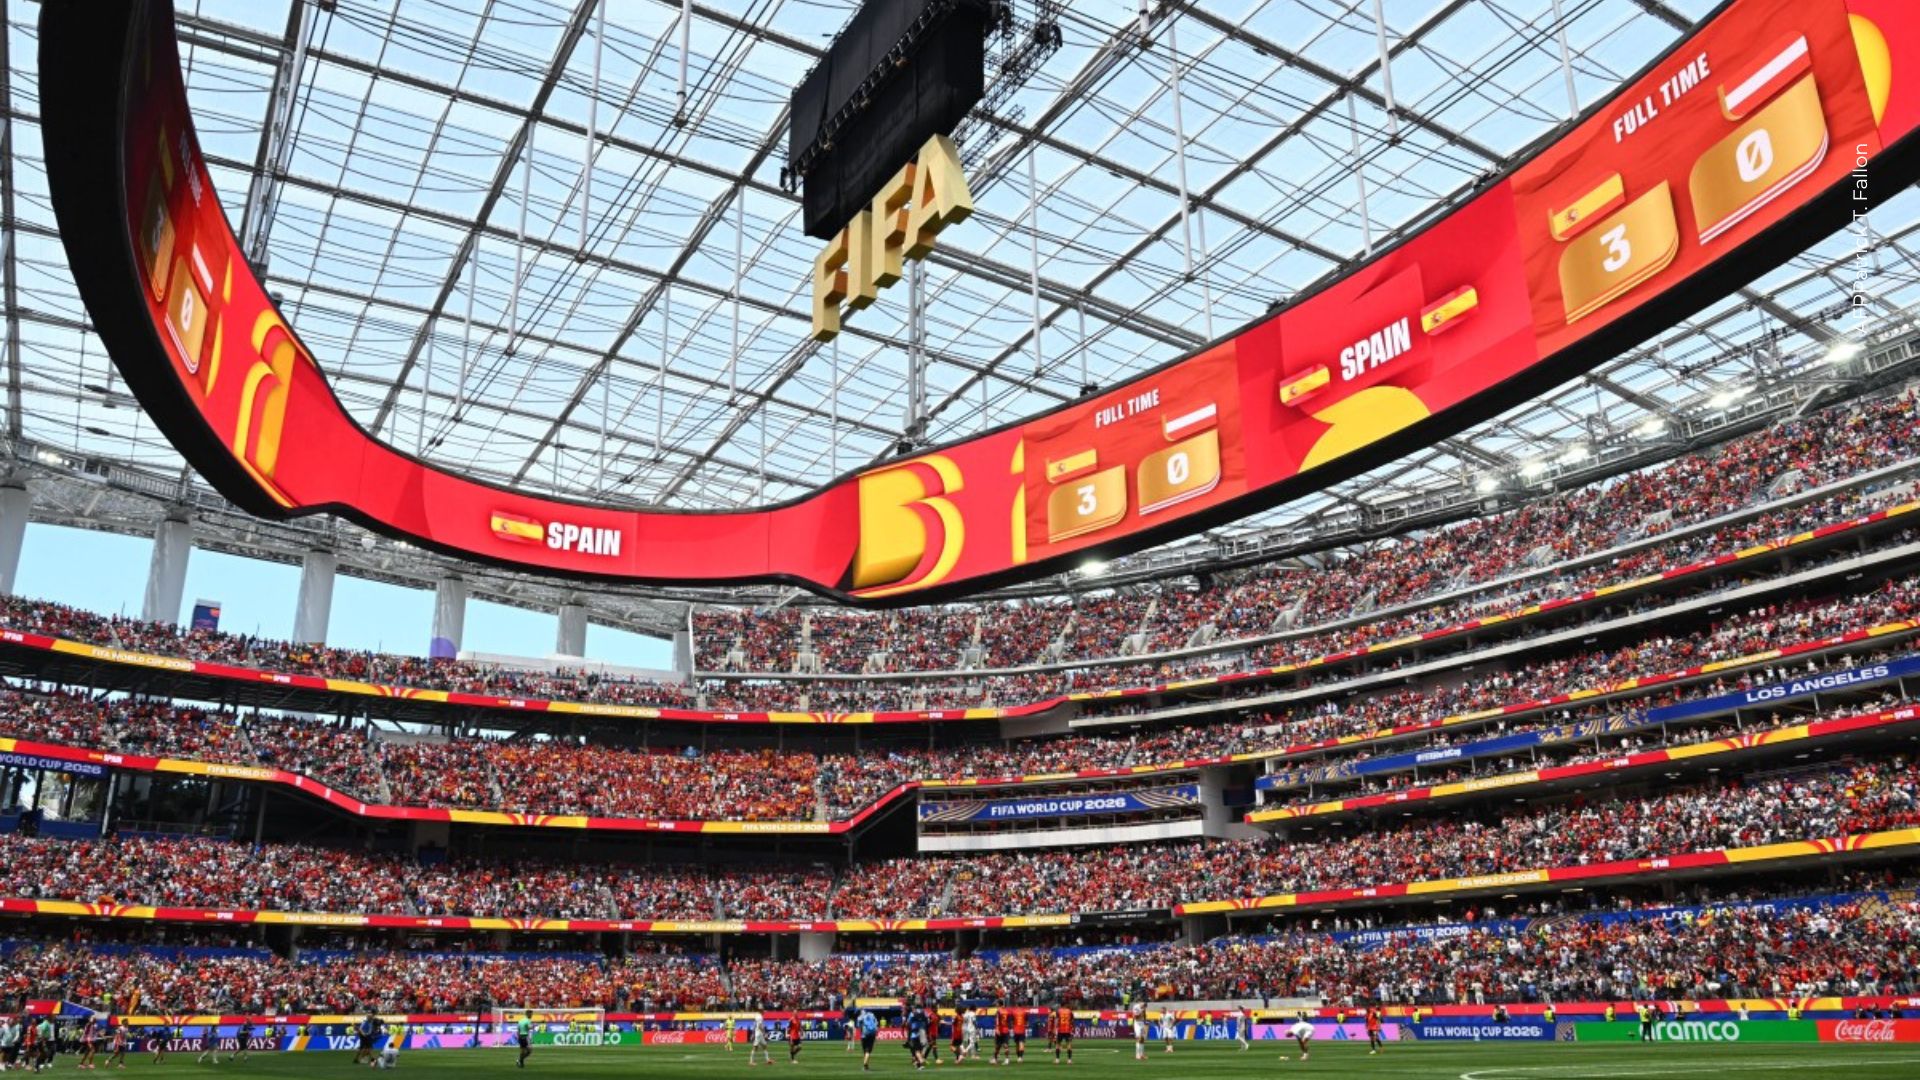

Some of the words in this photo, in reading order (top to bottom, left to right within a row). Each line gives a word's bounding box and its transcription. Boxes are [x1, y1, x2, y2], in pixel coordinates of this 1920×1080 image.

[1613, 95, 1658, 144] FULL
[1659, 52, 1711, 107] TIME
[1735, 128, 1773, 182] 0
[812, 133, 973, 343] FIFA
[1599, 223, 1631, 273] 3
[1339, 316, 1411, 381] SPAIN
[1095, 402, 1124, 429] FULL
[1127, 388, 1160, 414] TIME
[1167, 453, 1190, 485] 0
[1077, 484, 1097, 516] 3
[546, 521, 622, 557] SPAIN
[1746, 686, 1786, 703] LOS
[1790, 665, 1889, 694] ANGELES
[38, 760, 62, 770] CUP
[63, 762, 102, 775] 2026
[991, 806, 1015, 817] FIFA
[1017, 803, 1058, 814] WORLD
[1060, 801, 1083, 812] CUP
[1085, 798, 1126, 809] 2026
[553, 1032, 621, 1044] aramco
[1083, 1027, 1116, 1038] AIRWAYS
[1204, 1025, 1229, 1039] VISA
[1424, 1027, 1445, 1037] FIFA
[1445, 1027, 1480, 1037] WORLD
[1482, 1026, 1502, 1037] CUP
